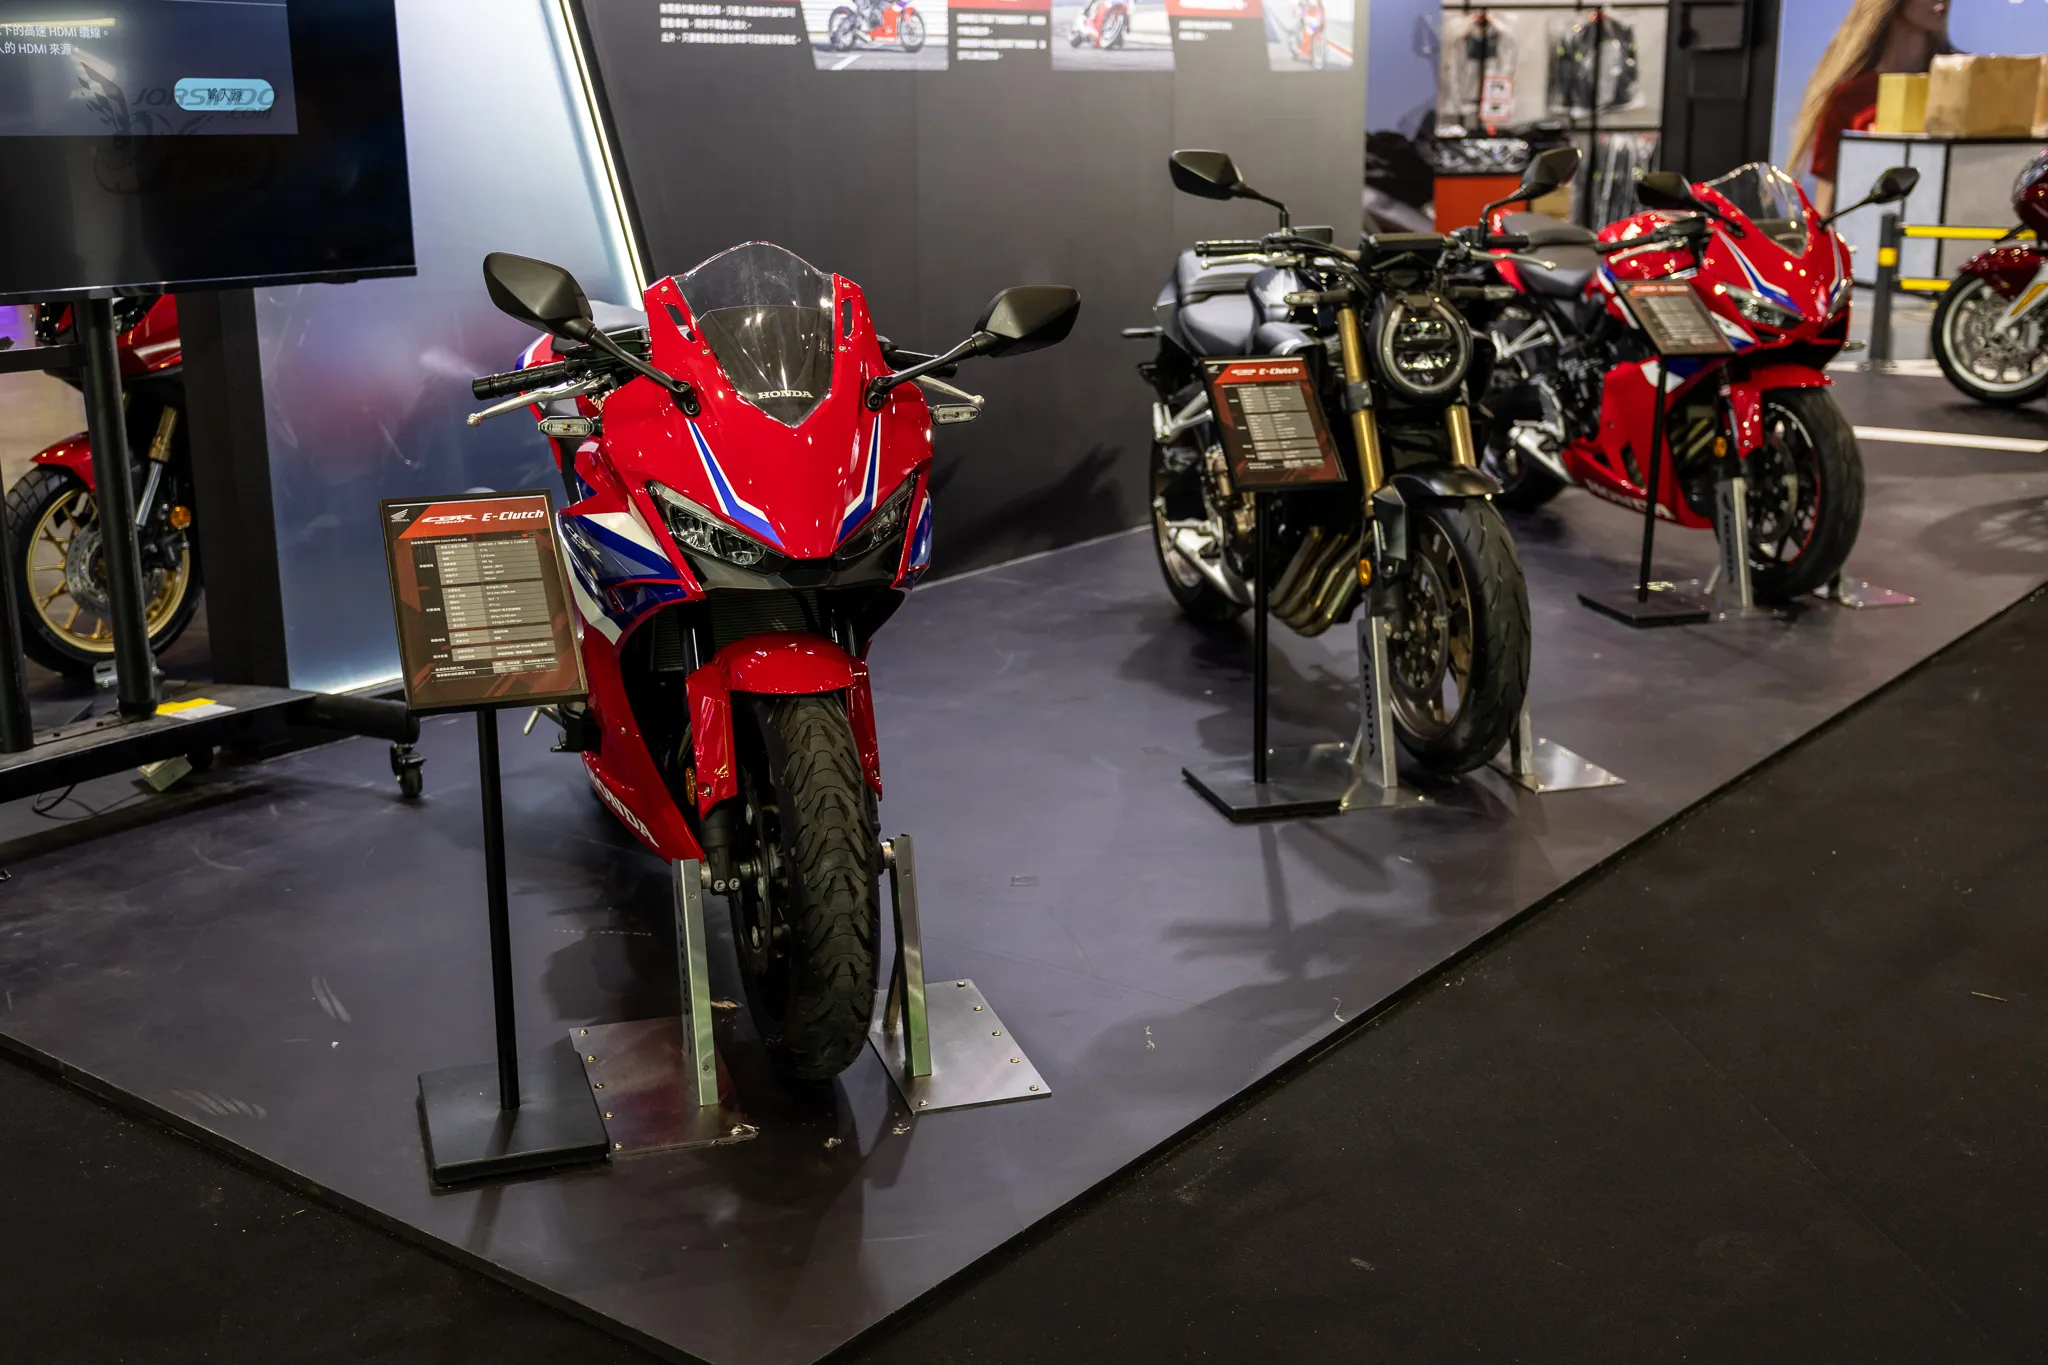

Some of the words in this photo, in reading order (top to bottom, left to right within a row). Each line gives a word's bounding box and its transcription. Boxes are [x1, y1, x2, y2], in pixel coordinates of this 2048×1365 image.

[0, 25, 47, 38] 下的高速
[49, 27, 77, 37] HDMI
[18, 43, 47, 54] HDMI
[757, 390, 814, 399] HONDA
[481, 509, 544, 521] E-Clutch
[584, 760, 659, 848] HONDA
